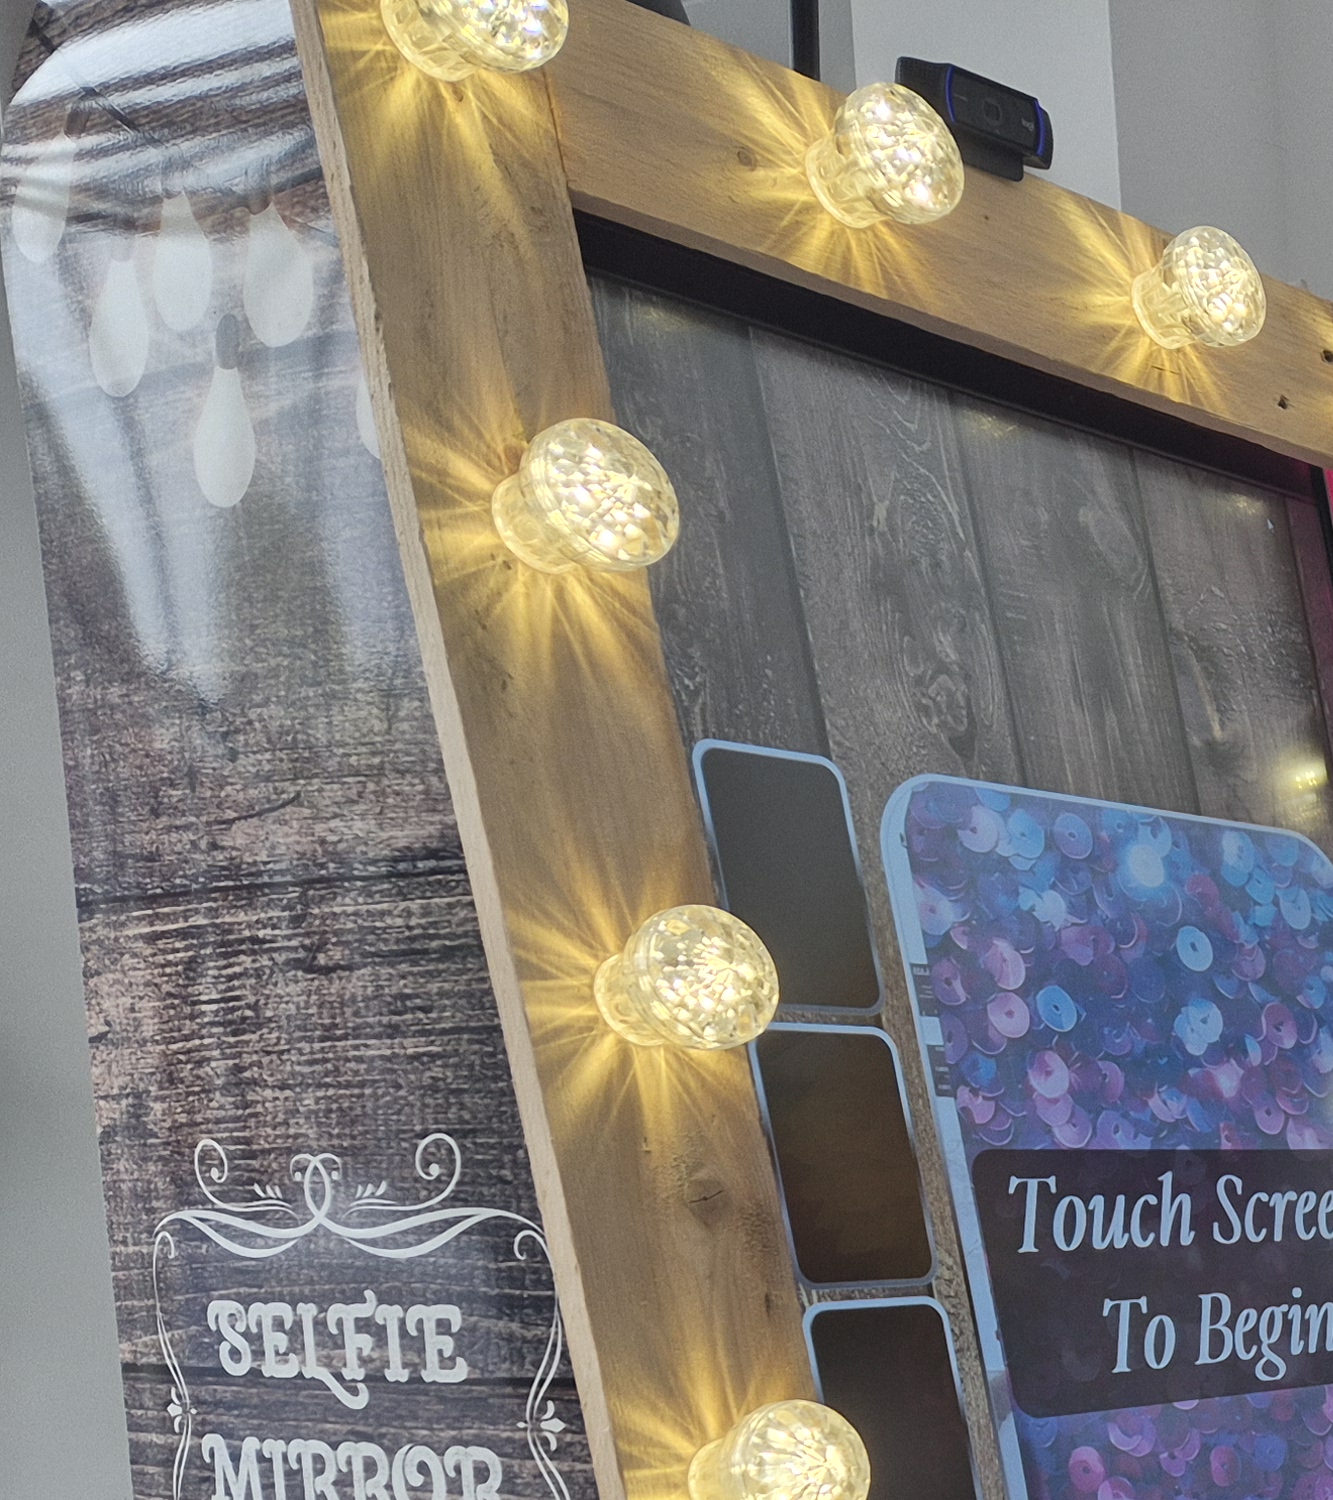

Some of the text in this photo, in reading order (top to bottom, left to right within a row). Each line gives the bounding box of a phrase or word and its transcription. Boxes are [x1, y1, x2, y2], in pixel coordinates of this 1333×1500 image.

[1007, 1170, 1197, 1254] Touch
[207, 1289, 468, 1410] SELFIE
[1102, 1295, 1177, 1374] To
